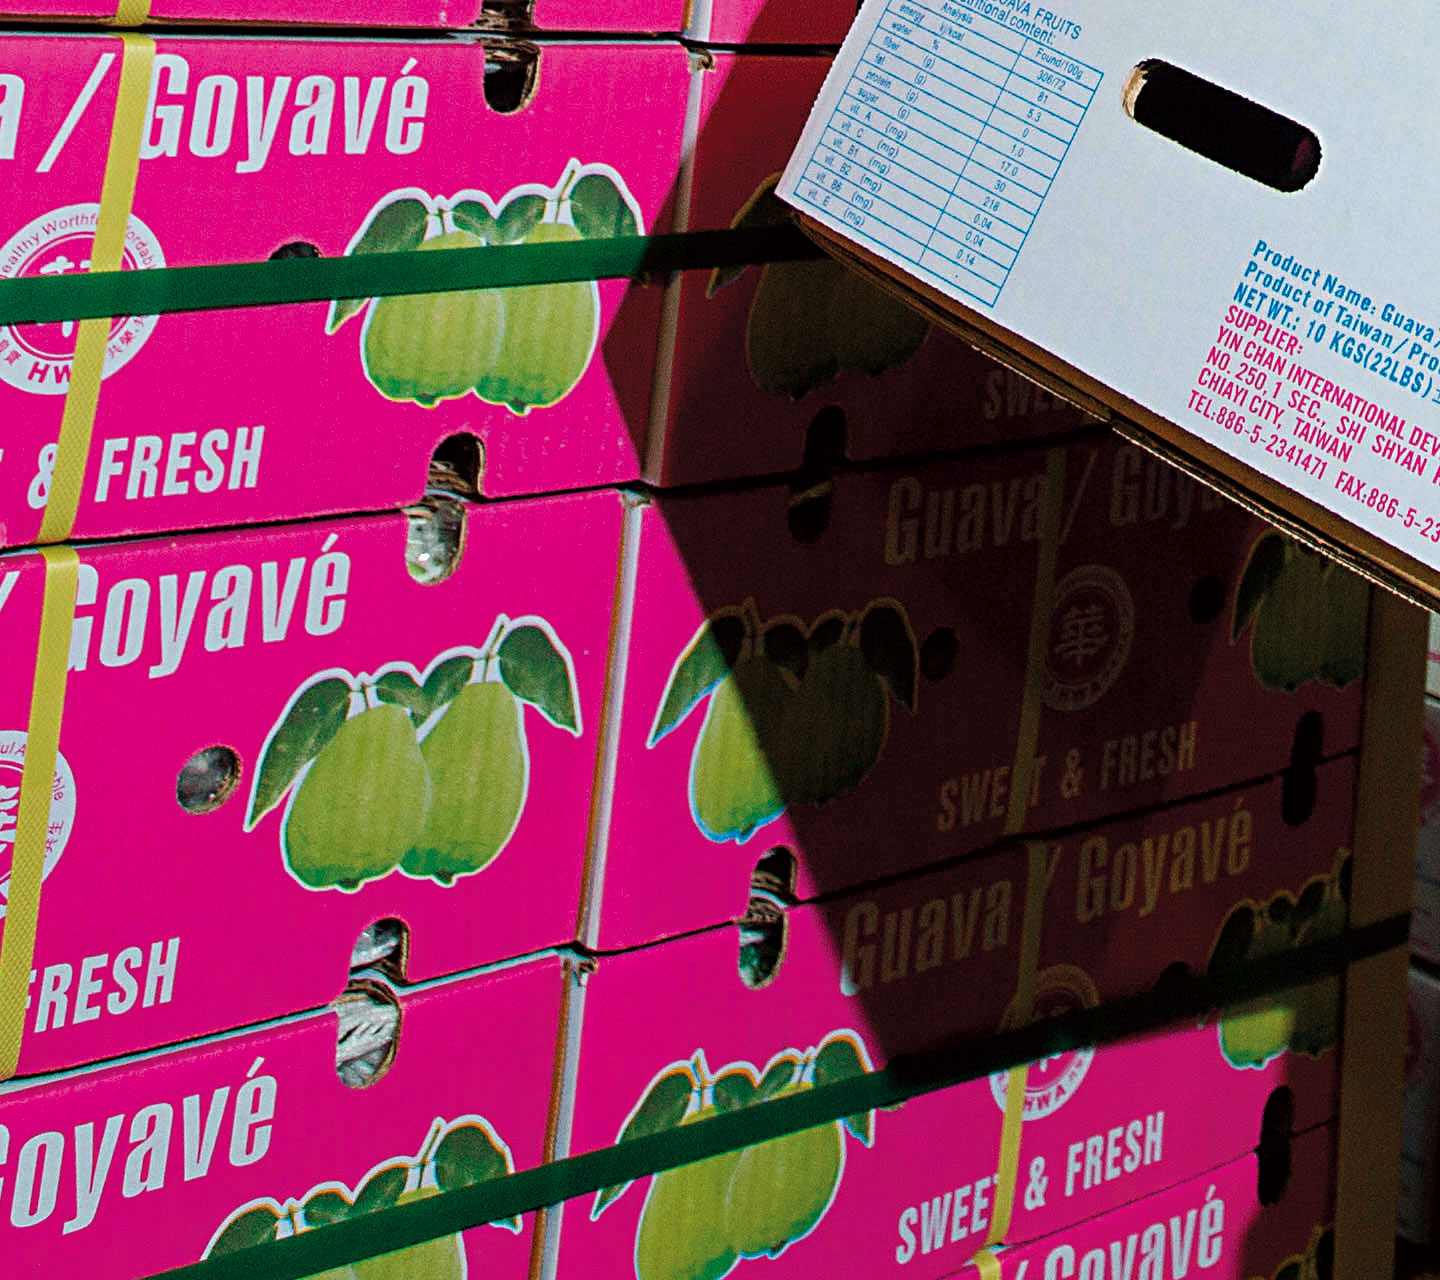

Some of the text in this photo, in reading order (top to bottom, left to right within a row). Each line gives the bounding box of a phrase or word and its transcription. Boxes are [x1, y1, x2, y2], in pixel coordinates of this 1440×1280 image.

[1033, 6, 1082, 40] FRUITS
[139, 45, 428, 173] Goyavé
[1224, 305, 1302, 355] SUPPLIER:
[1233, 281, 1267, 312] NET
[1306, 319, 1326, 343] 10
[1243, 260, 1311, 307] Product
[1312, 299, 1334, 317] of
[1335, 304, 1392, 348] Taiwan
[1252, 239, 1320, 286] Product
[1322, 273, 1376, 314] Name:
[1380, 303, 1434, 343] Guava
[1198, 367, 1352, 462] CHIAYI CITY, TAIWAN
[1206, 346, 1230, 373] NO.
[1336, 415, 1366, 443] SHI
[1371, 434, 1427, 475] SHYAN
[1216, 325, 1243, 352] YIN
[1243, 340, 1287, 375] CHAN
[1286, 363, 1405, 439] INTERNATIONAL
[95, 426, 264, 502] FRESH
[884, 473, 1048, 566] Guava
[937, 755, 1048, 832] SWET
[1101, 720, 1198, 790] FRESH
[841, 797, 1253, 995] Guava Goyavé
[27, 937, 180, 1033] RESH
[895, 1111, 1165, 1264] SWEE & FRESH
